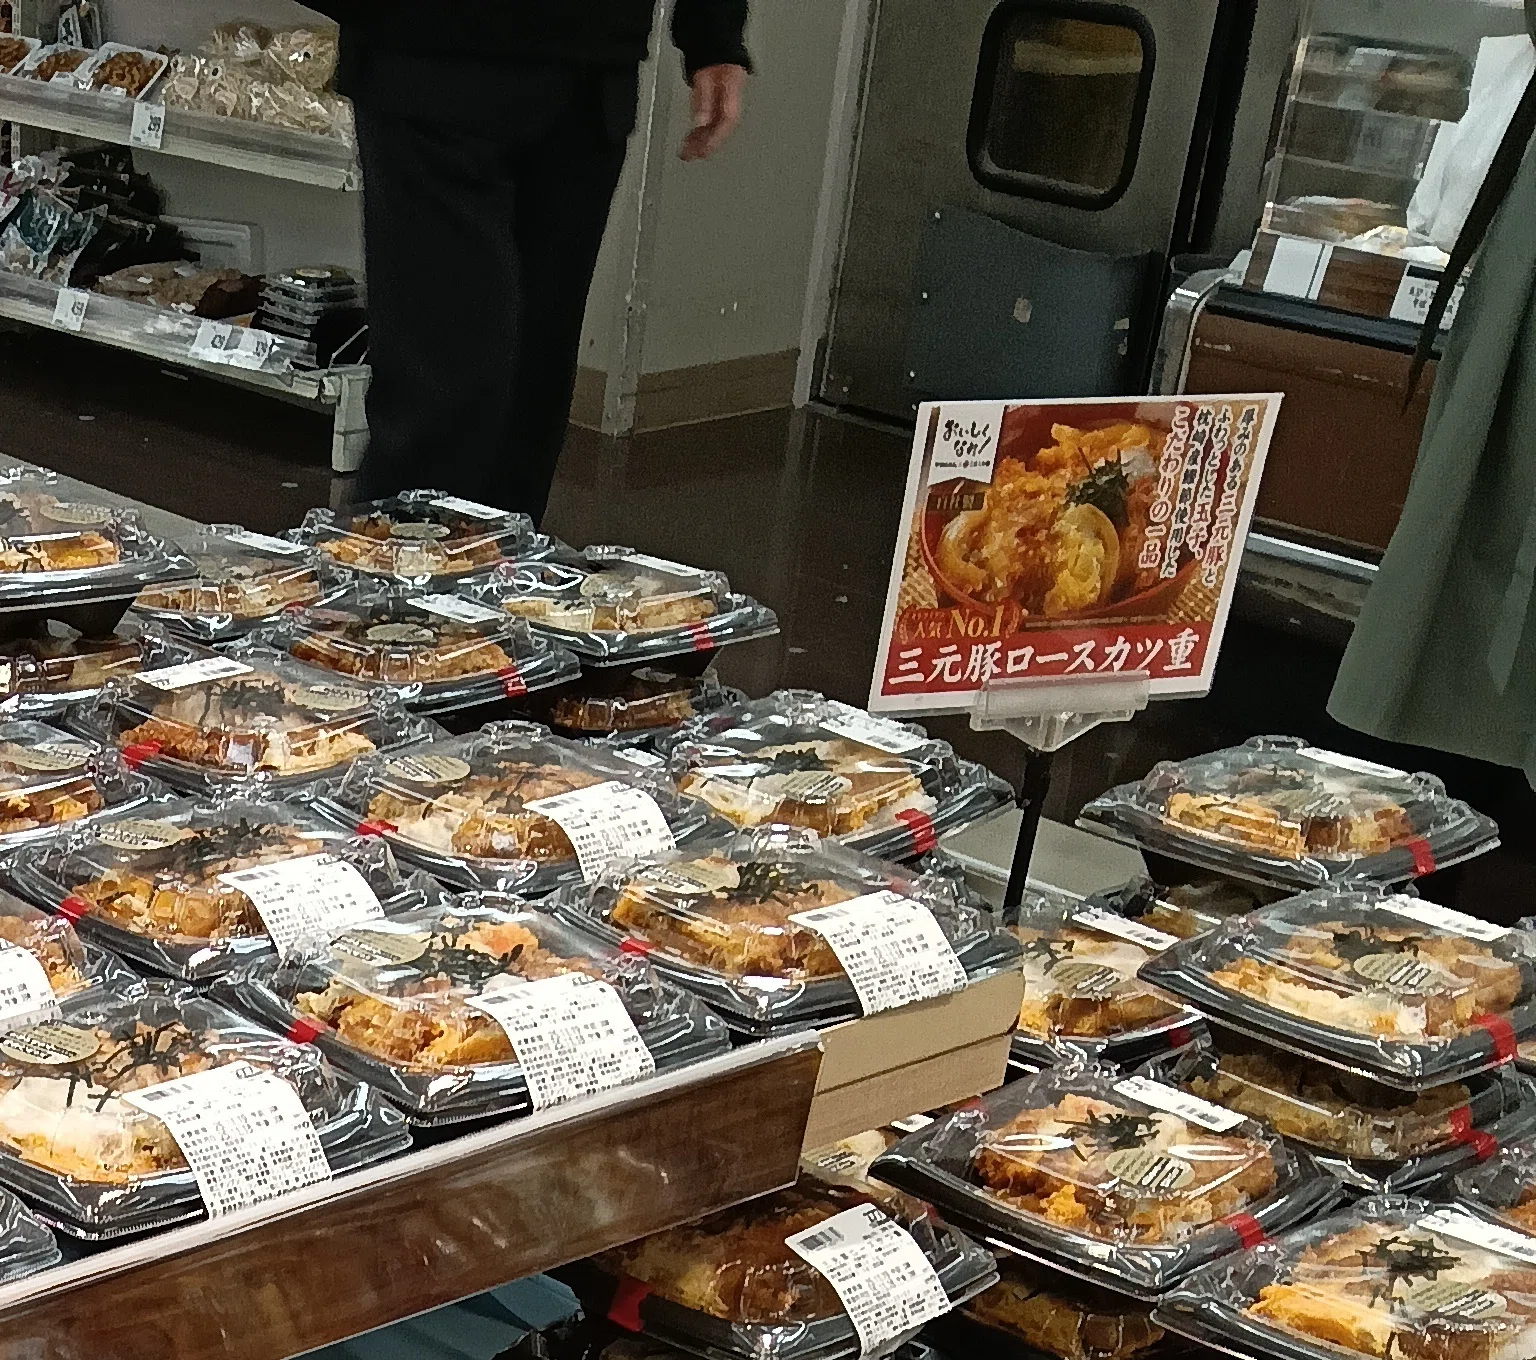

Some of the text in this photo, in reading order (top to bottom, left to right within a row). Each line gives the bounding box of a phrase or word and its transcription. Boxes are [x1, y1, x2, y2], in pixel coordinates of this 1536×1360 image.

[1138, 404, 1192, 569] こだわりの一品
[946, 604, 1005, 639] No.1
[888, 627, 1200, 686] 三元豚ロースカツ重
